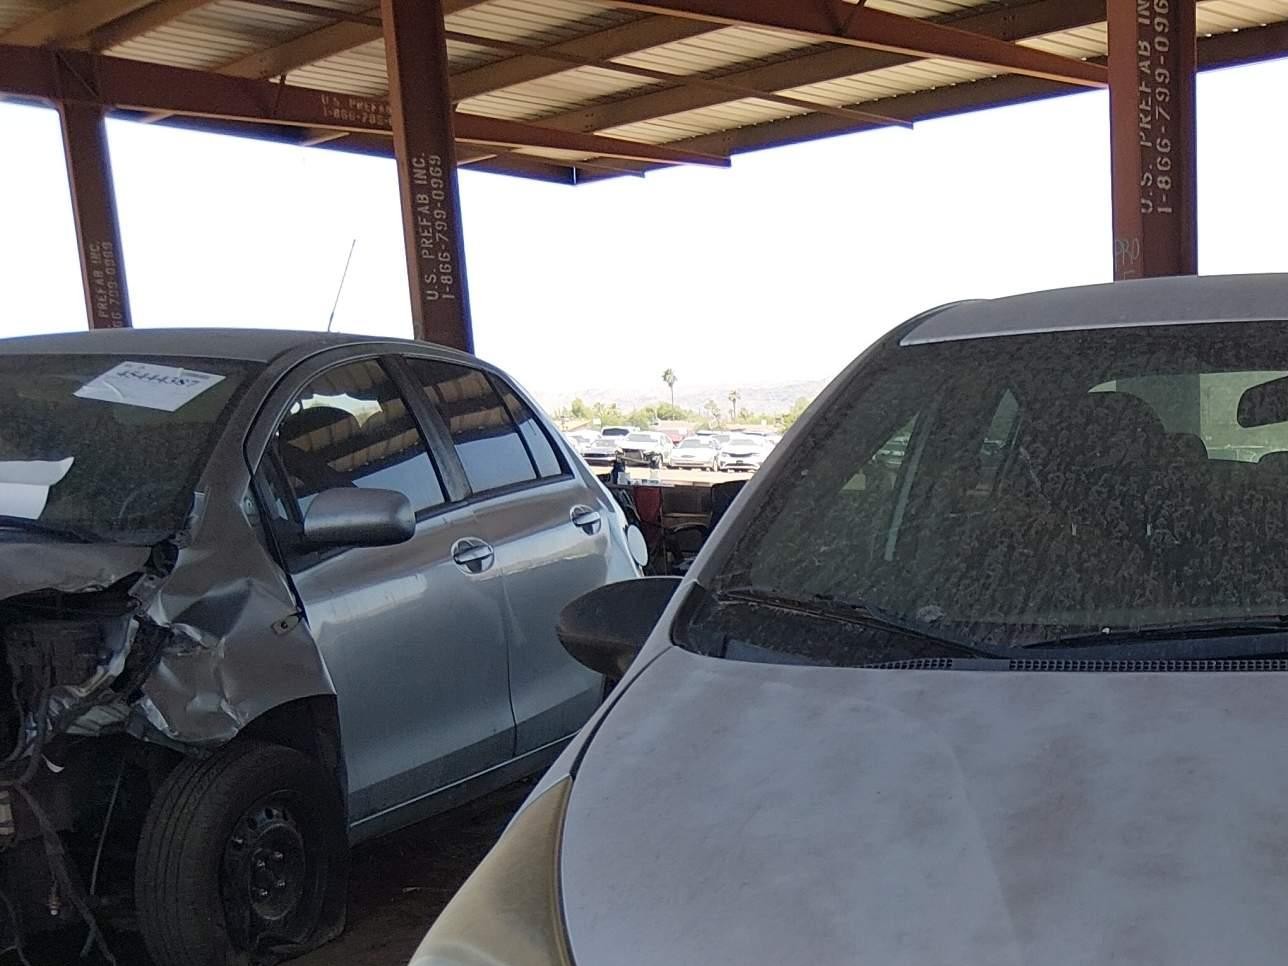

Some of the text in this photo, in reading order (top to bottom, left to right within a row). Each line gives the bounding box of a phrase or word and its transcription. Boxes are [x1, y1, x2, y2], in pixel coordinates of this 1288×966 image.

[1137, 40, 1152, 146] PREFAB
[412, 153, 439, 300] U.S. PREFAB INC.
[429, 155, 455, 300] 1-866-799-0969
[1140, 164, 1153, 214] U.S.
